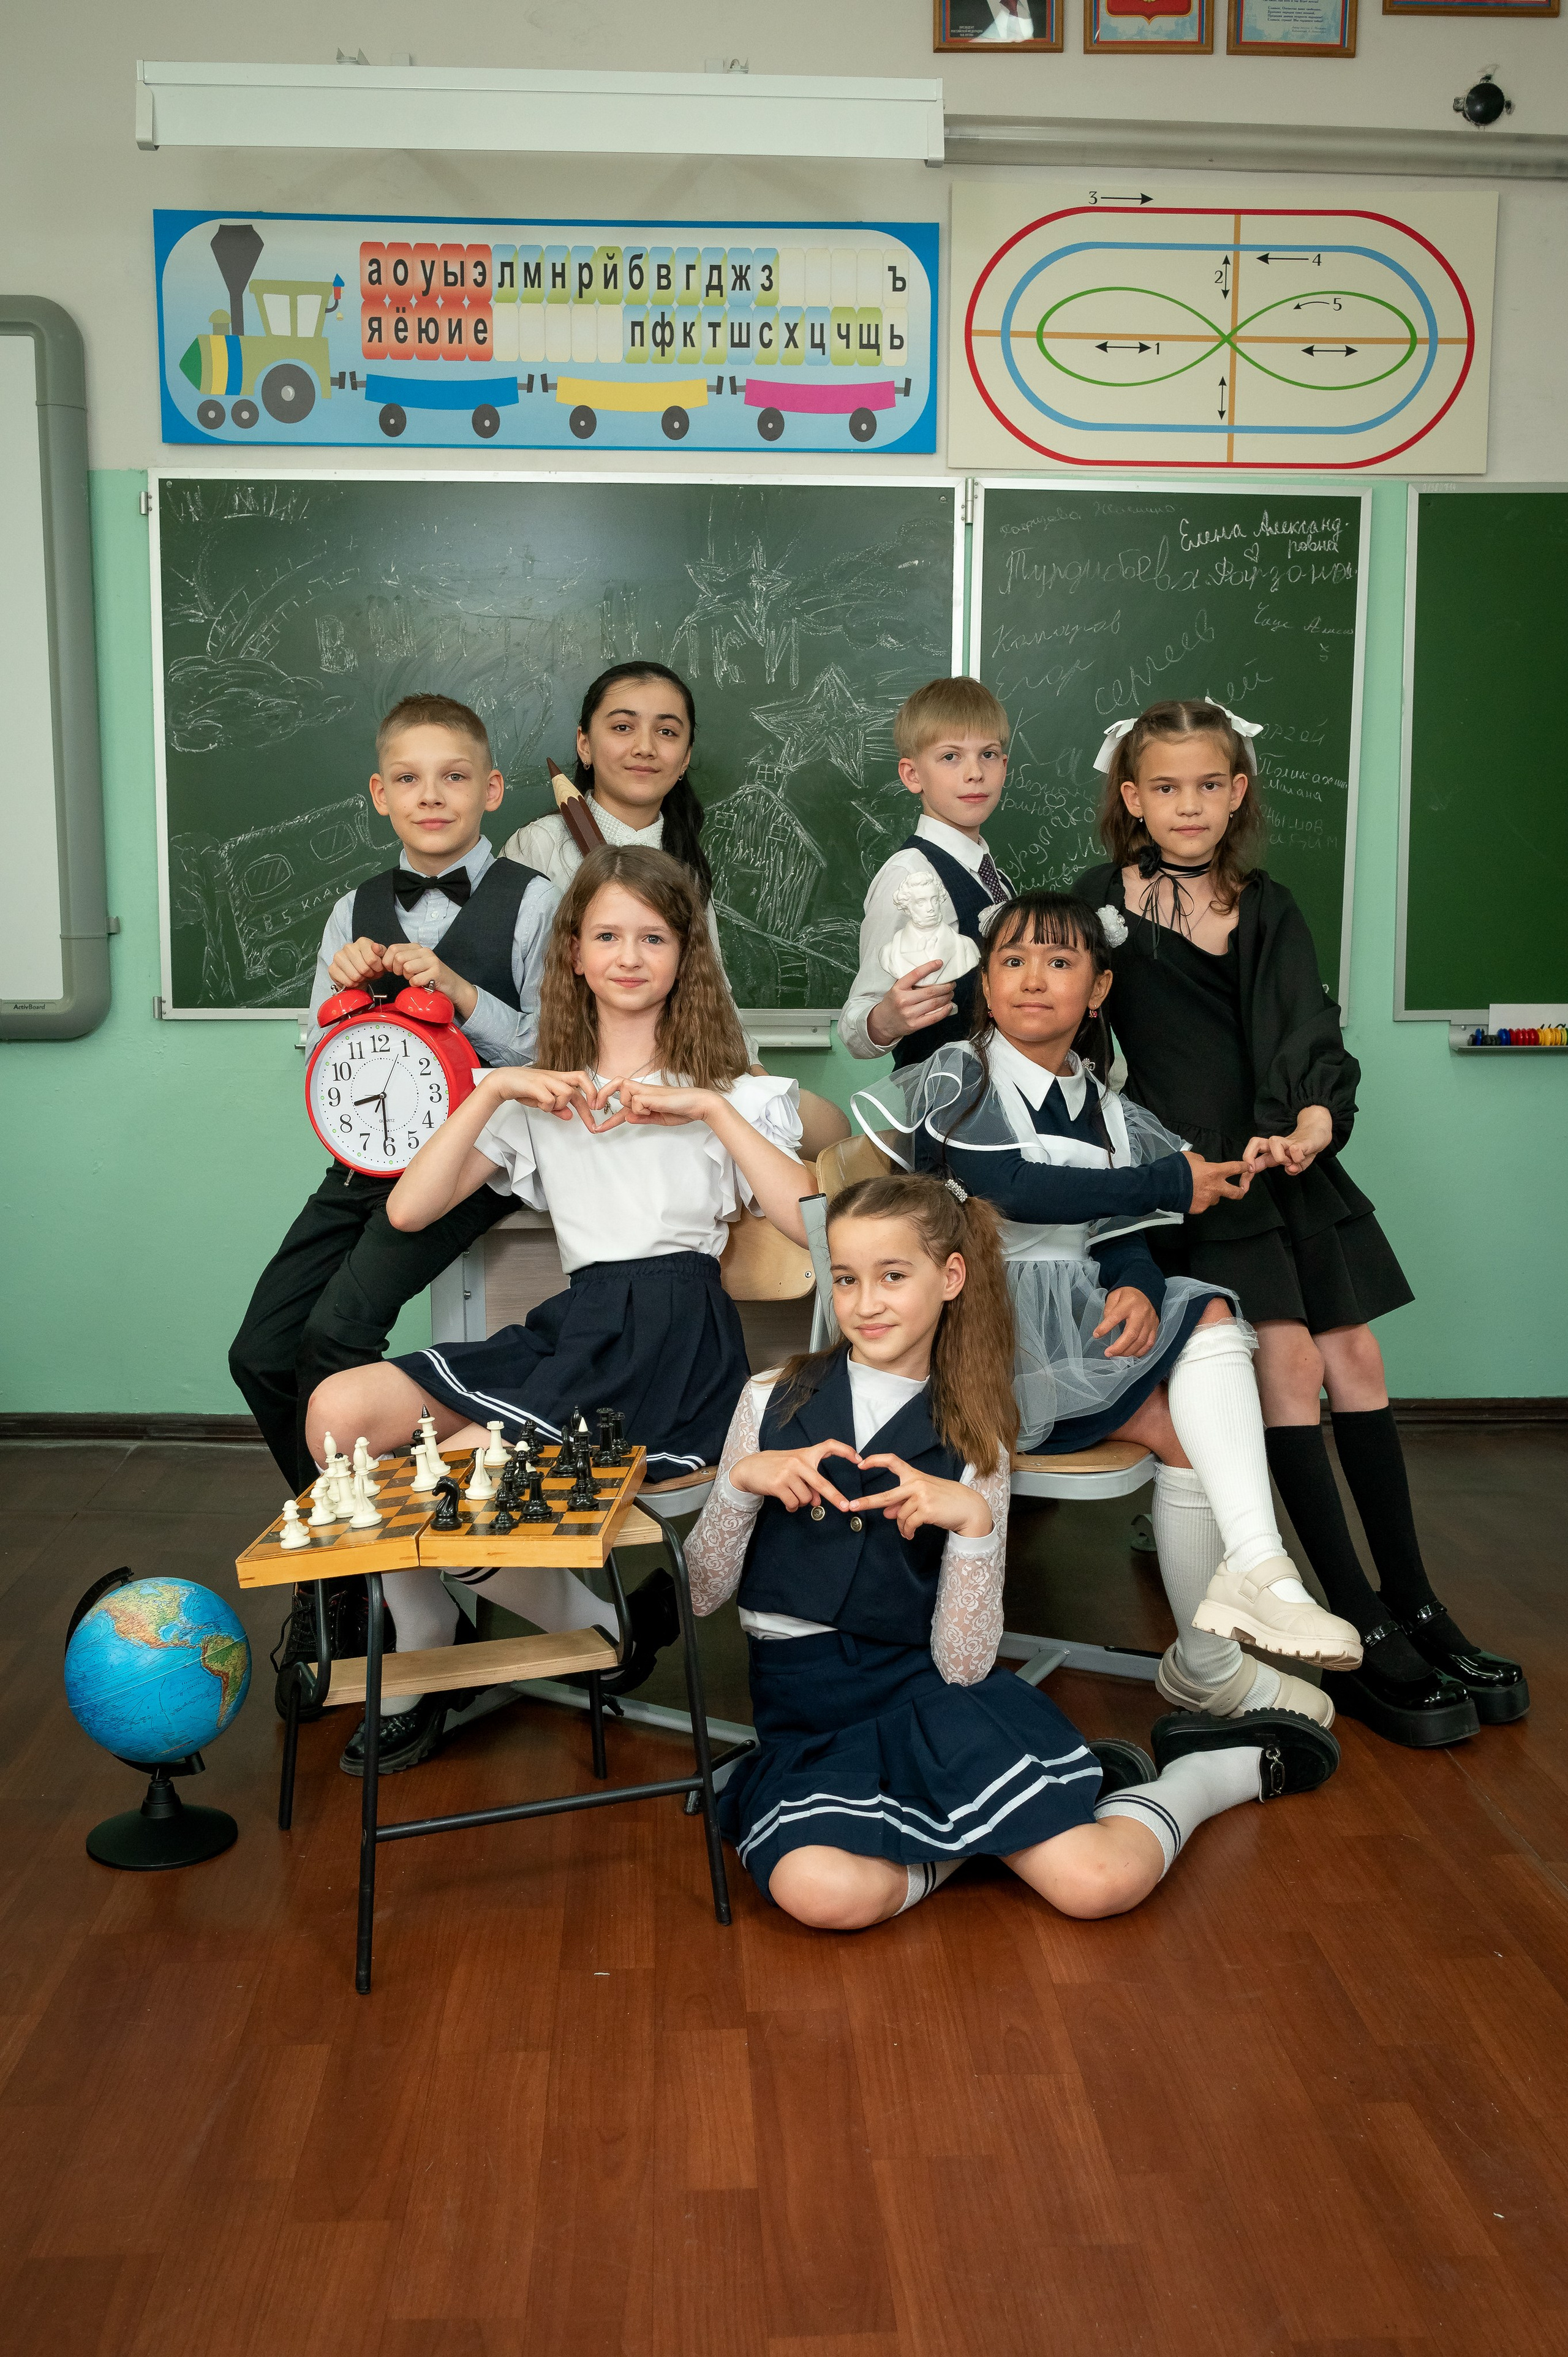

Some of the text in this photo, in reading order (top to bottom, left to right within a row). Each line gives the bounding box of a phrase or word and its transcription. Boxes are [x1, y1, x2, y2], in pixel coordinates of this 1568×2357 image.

[1088, 192, 1098, 205] 3
[1312, 254, 1322, 266] 4
[1215, 271, 1223, 284] 2
[1333, 298, 1342, 311] 5
[1154, 343, 1161, 355] 1
[1180, 518, 1246, 551] Елена
[1288, 535, 1340, 559] ровна
[282, 909, 292, 926] 5
[347, 1041, 366, 1060] 11
[370, 1035, 391, 1053] 12
[401, 1039, 410, 1057] 1
[332, 1062, 352, 1081] 10
[419, 1058, 432, 1076] 2
[328, 1087, 341, 1106] 9
[429, 1084, 442, 1103] 3
[340, 1114, 353, 1133] 8
[422, 1111, 434, 1128] 4
[360, 1133, 371, 1151] 7
[383, 1137, 396, 1156] 6
[408, 1131, 420, 1149] 5
